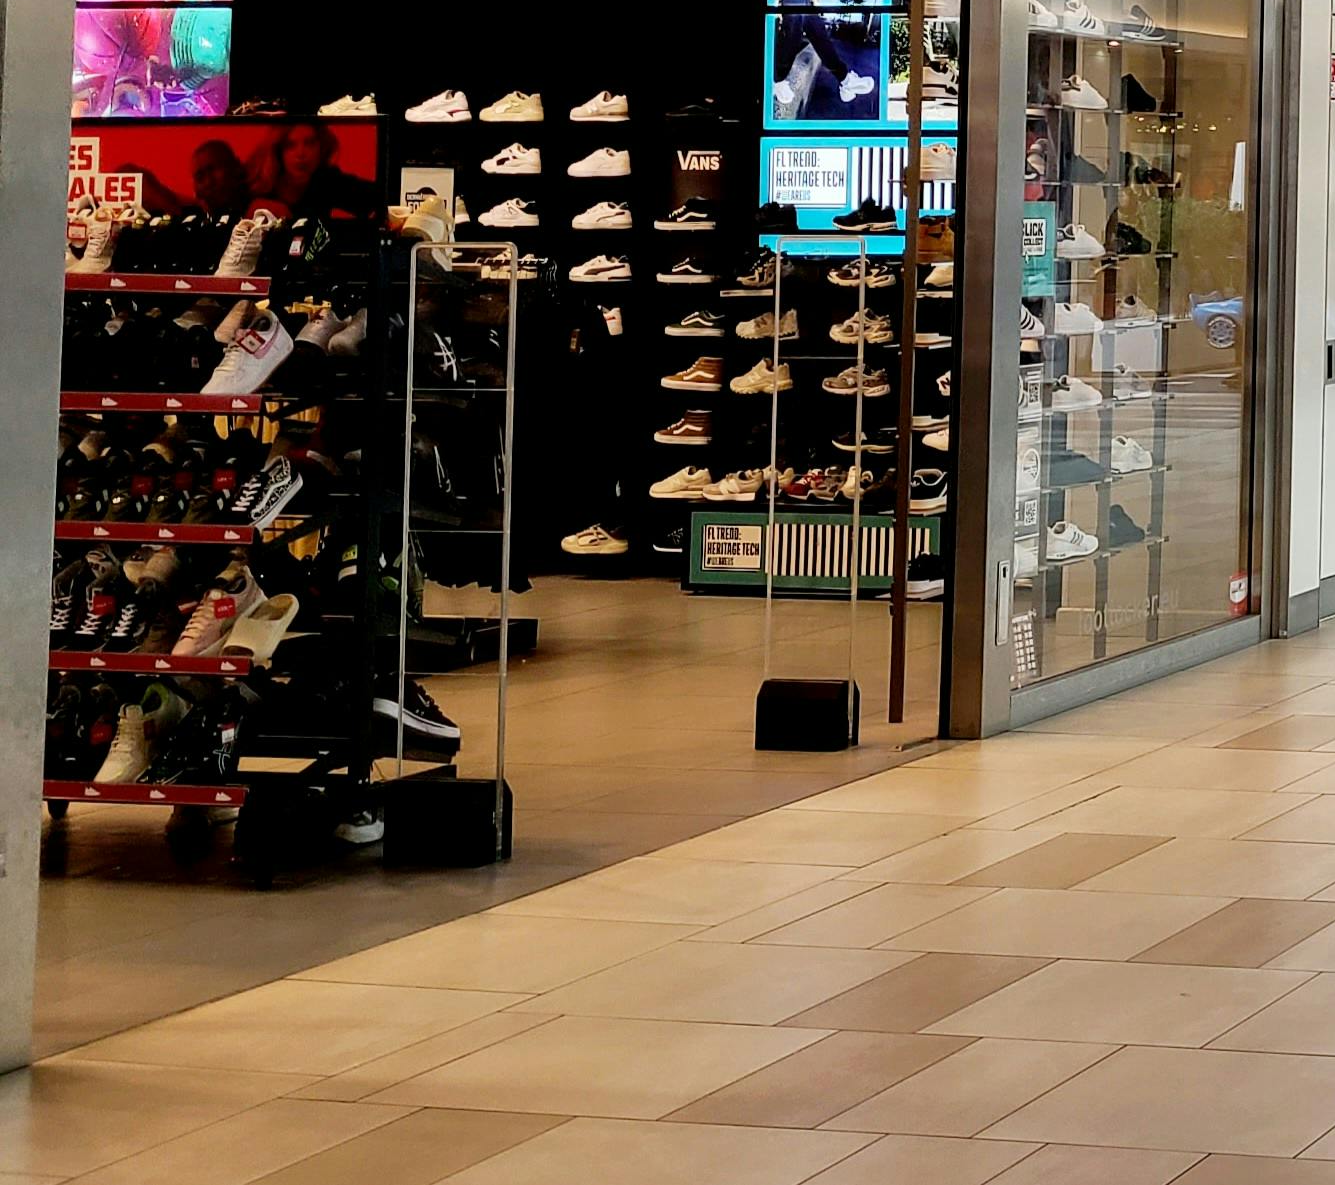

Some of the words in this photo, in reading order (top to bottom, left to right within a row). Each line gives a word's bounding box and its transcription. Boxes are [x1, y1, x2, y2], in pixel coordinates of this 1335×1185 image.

[676, 150, 722, 171] VANS
[775, 170, 821, 188] HERITAGE
[822, 170, 845, 188] TECH
[707, 541, 741, 556] HERITAGE
[742, 542, 760, 556] TECH
